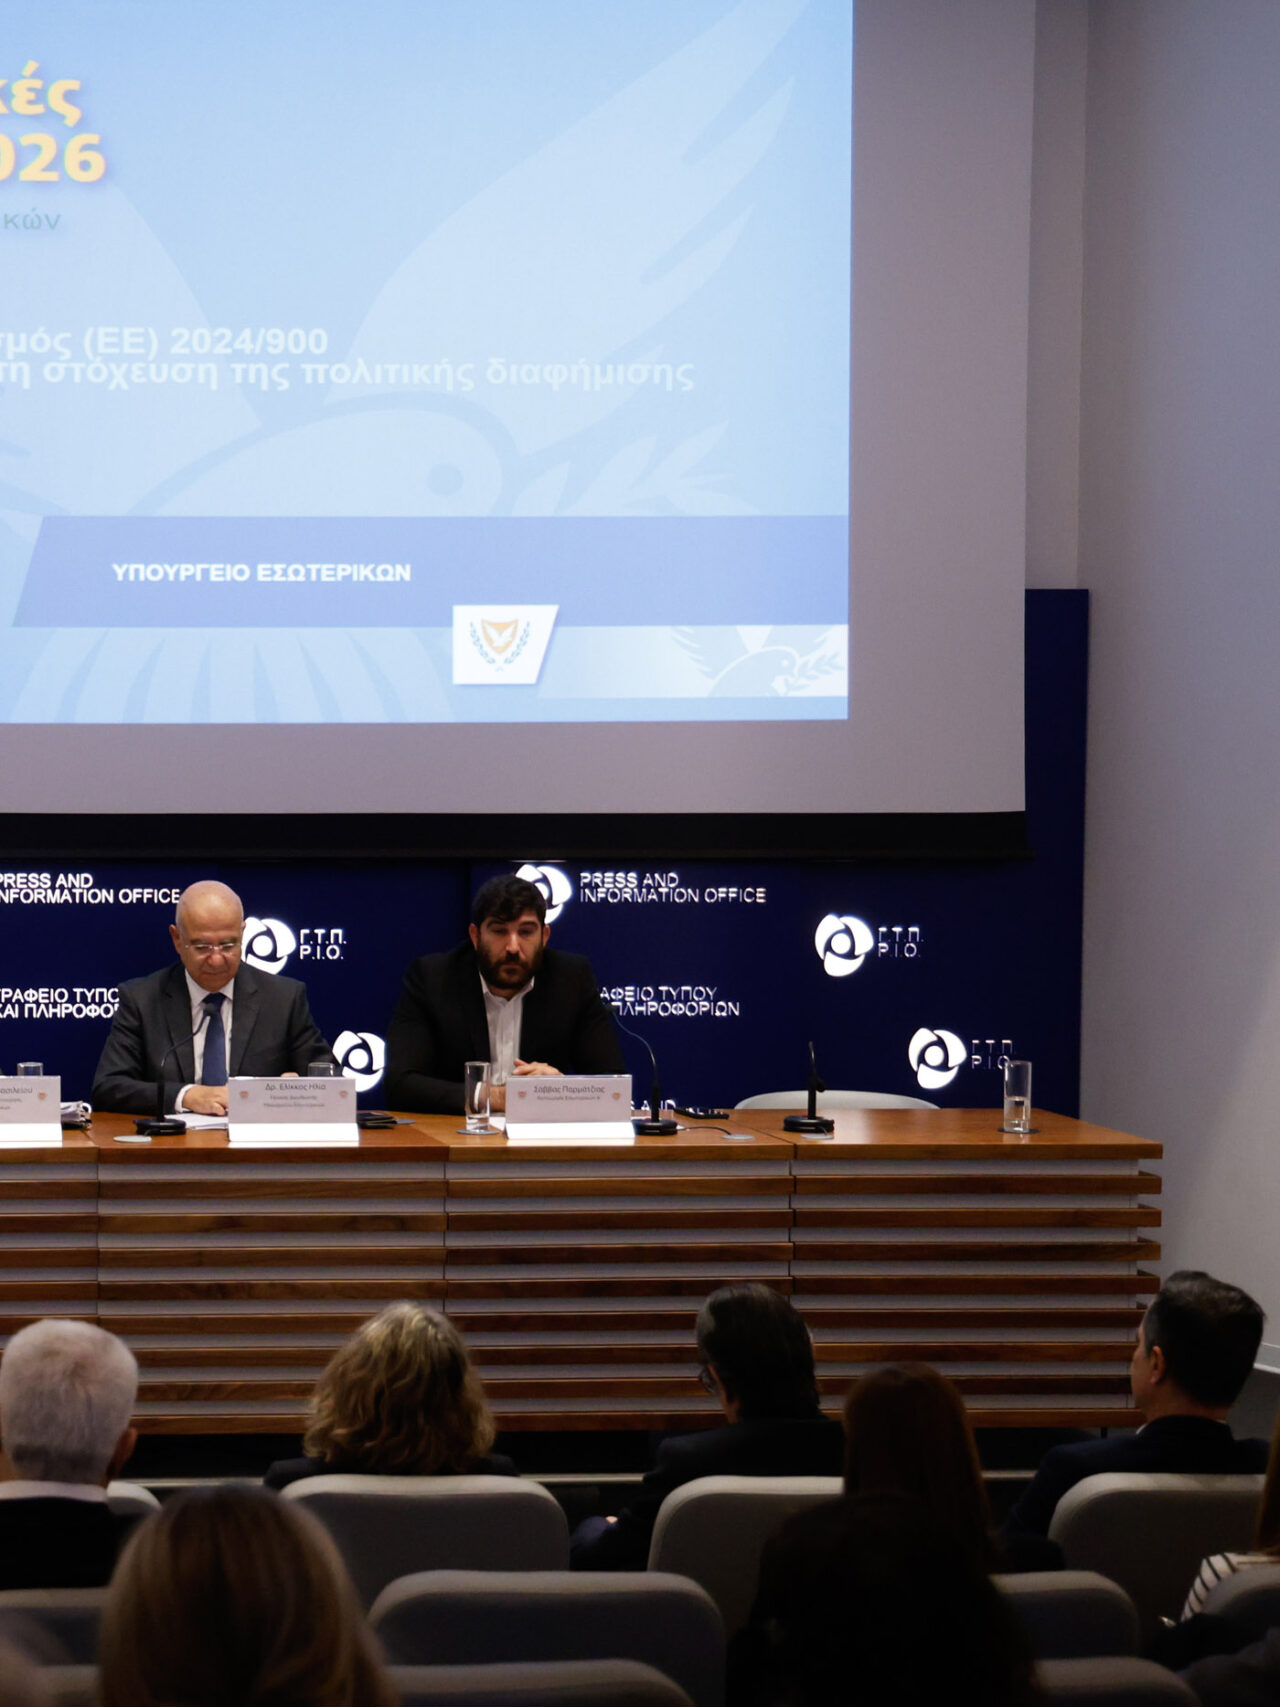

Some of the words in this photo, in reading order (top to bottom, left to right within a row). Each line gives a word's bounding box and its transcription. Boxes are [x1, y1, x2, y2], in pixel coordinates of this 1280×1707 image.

[84, 327, 158, 360] (ΕΕ)
[170, 327, 329, 356] 2024/900
[44, 356, 218, 390] στόχευση
[231, 359, 290, 391] της
[301, 356, 475, 390] πολιτικής
[487, 356, 695, 391] διαφήμισης
[112, 563, 250, 582] ΥΠΟΥΡΓΕΙΟ
[257, 563, 412, 582] ΕΣΩΤΕΡΙΚΩΝ
[55, 873, 94, 888] AND
[580, 872, 638, 888] PRESS
[642, 872, 679, 888] AND
[119, 888, 181, 904] OFFICE
[580, 888, 699, 903] INFORMATION
[704, 888, 767, 903] OFFICE
[300, 928, 347, 945] Γ.Τ.Π.
[300, 944, 344, 960] P.I.O.
[72, 987, 120, 1003] ΤΥΠΟ
[658, 986, 718, 1001] ΤΥΠΟΥ
